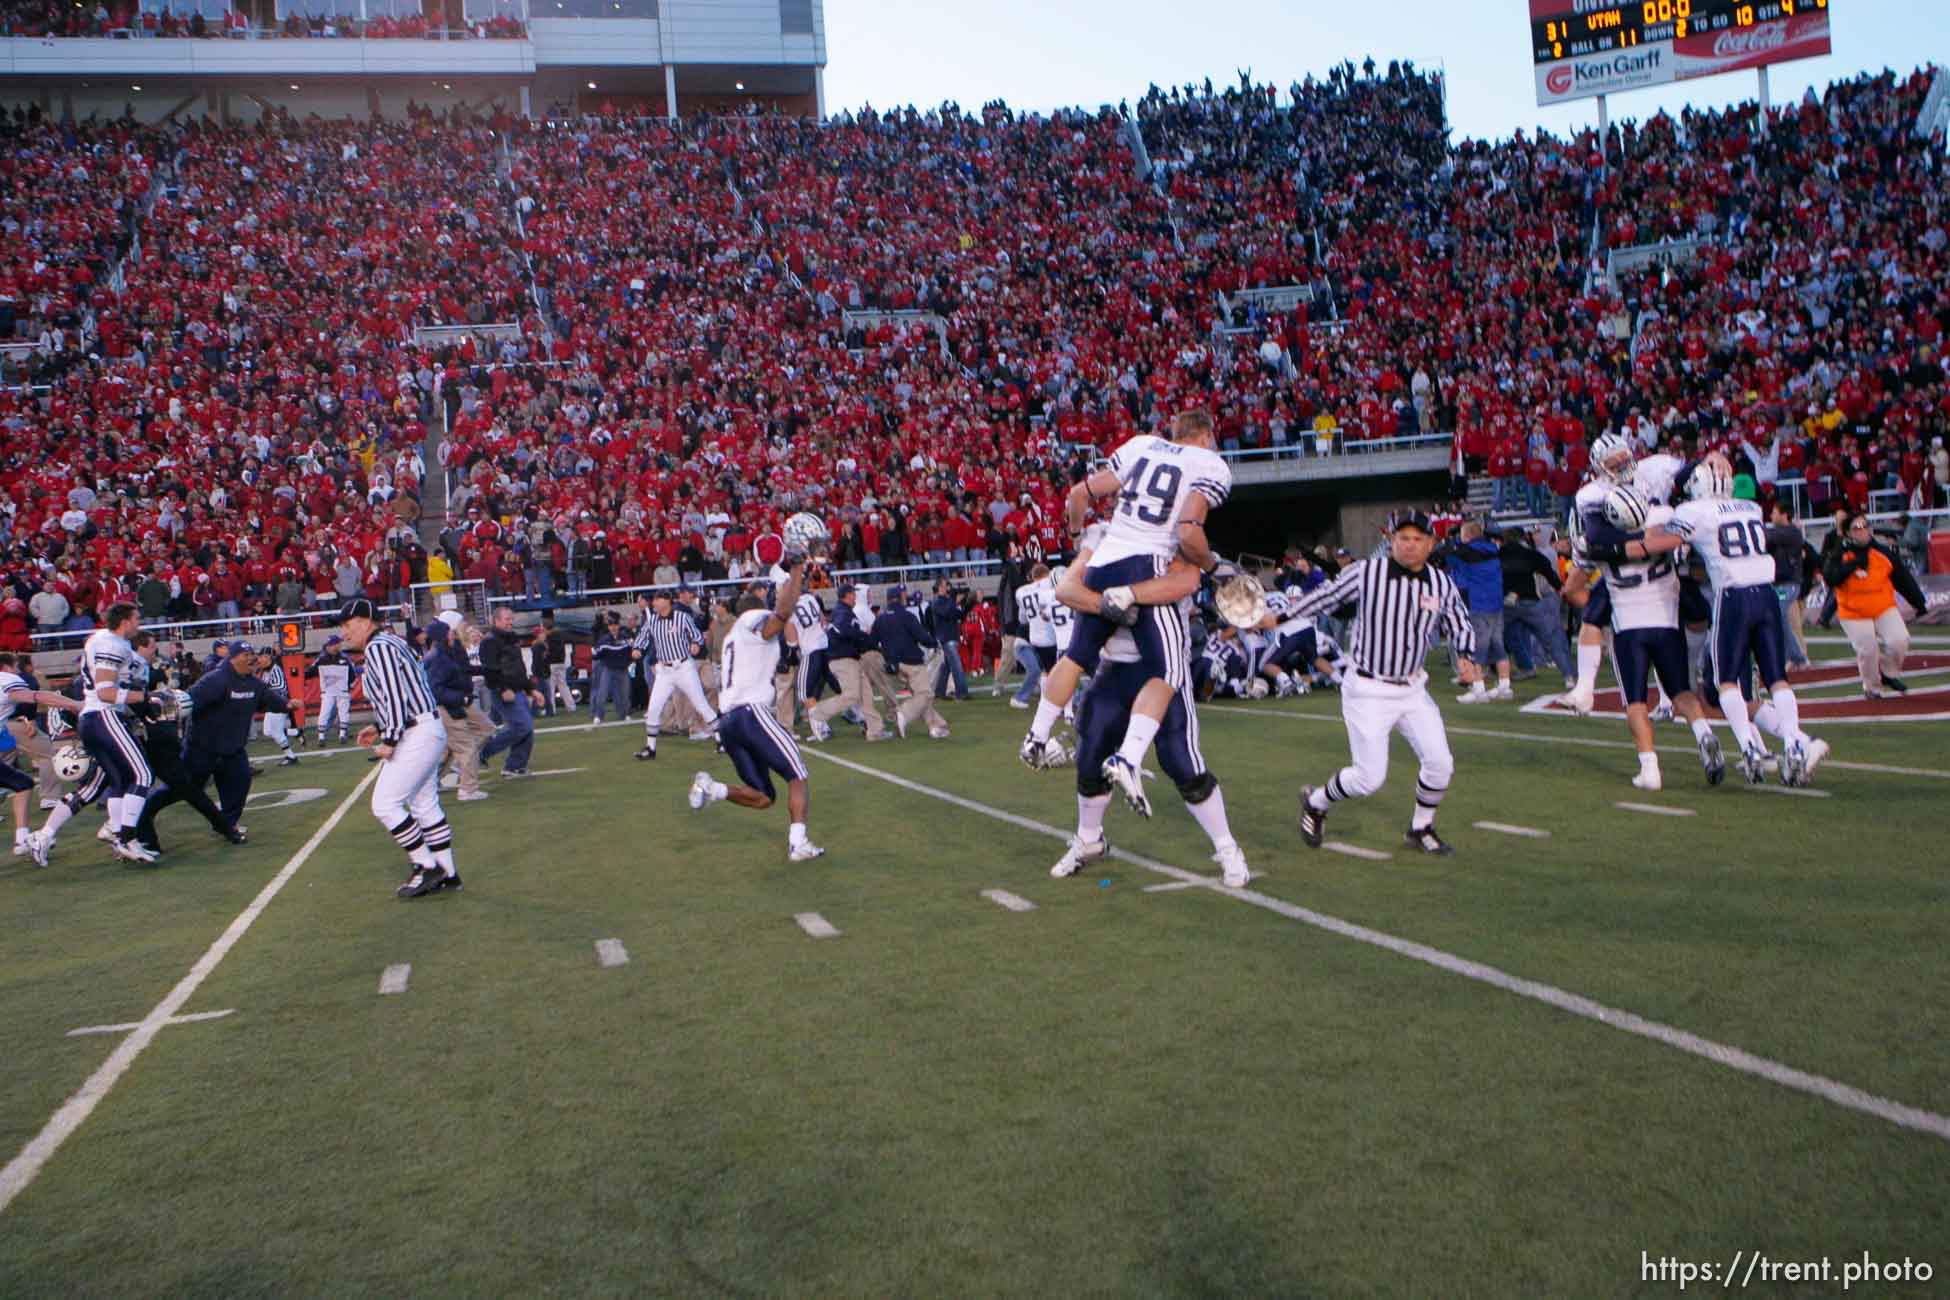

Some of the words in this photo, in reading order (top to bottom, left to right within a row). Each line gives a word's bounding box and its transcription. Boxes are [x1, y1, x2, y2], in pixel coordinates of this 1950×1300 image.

[1620, 28, 1636, 48] 11
[1643, 23, 1675, 41] DOWN
[1694, 16, 1708, 32] TO
[1712, 14, 1728, 29] GO
[1736, 5, 1753, 26] 10
[1575, 60, 1612, 81] Ken
[1613, 48, 1661, 75] Garff
[1119, 456, 1183, 527] 49
[1718, 519, 1769, 559] 80
[795, 600, 821, 629] 84
[282, 622, 299, 647] 3
